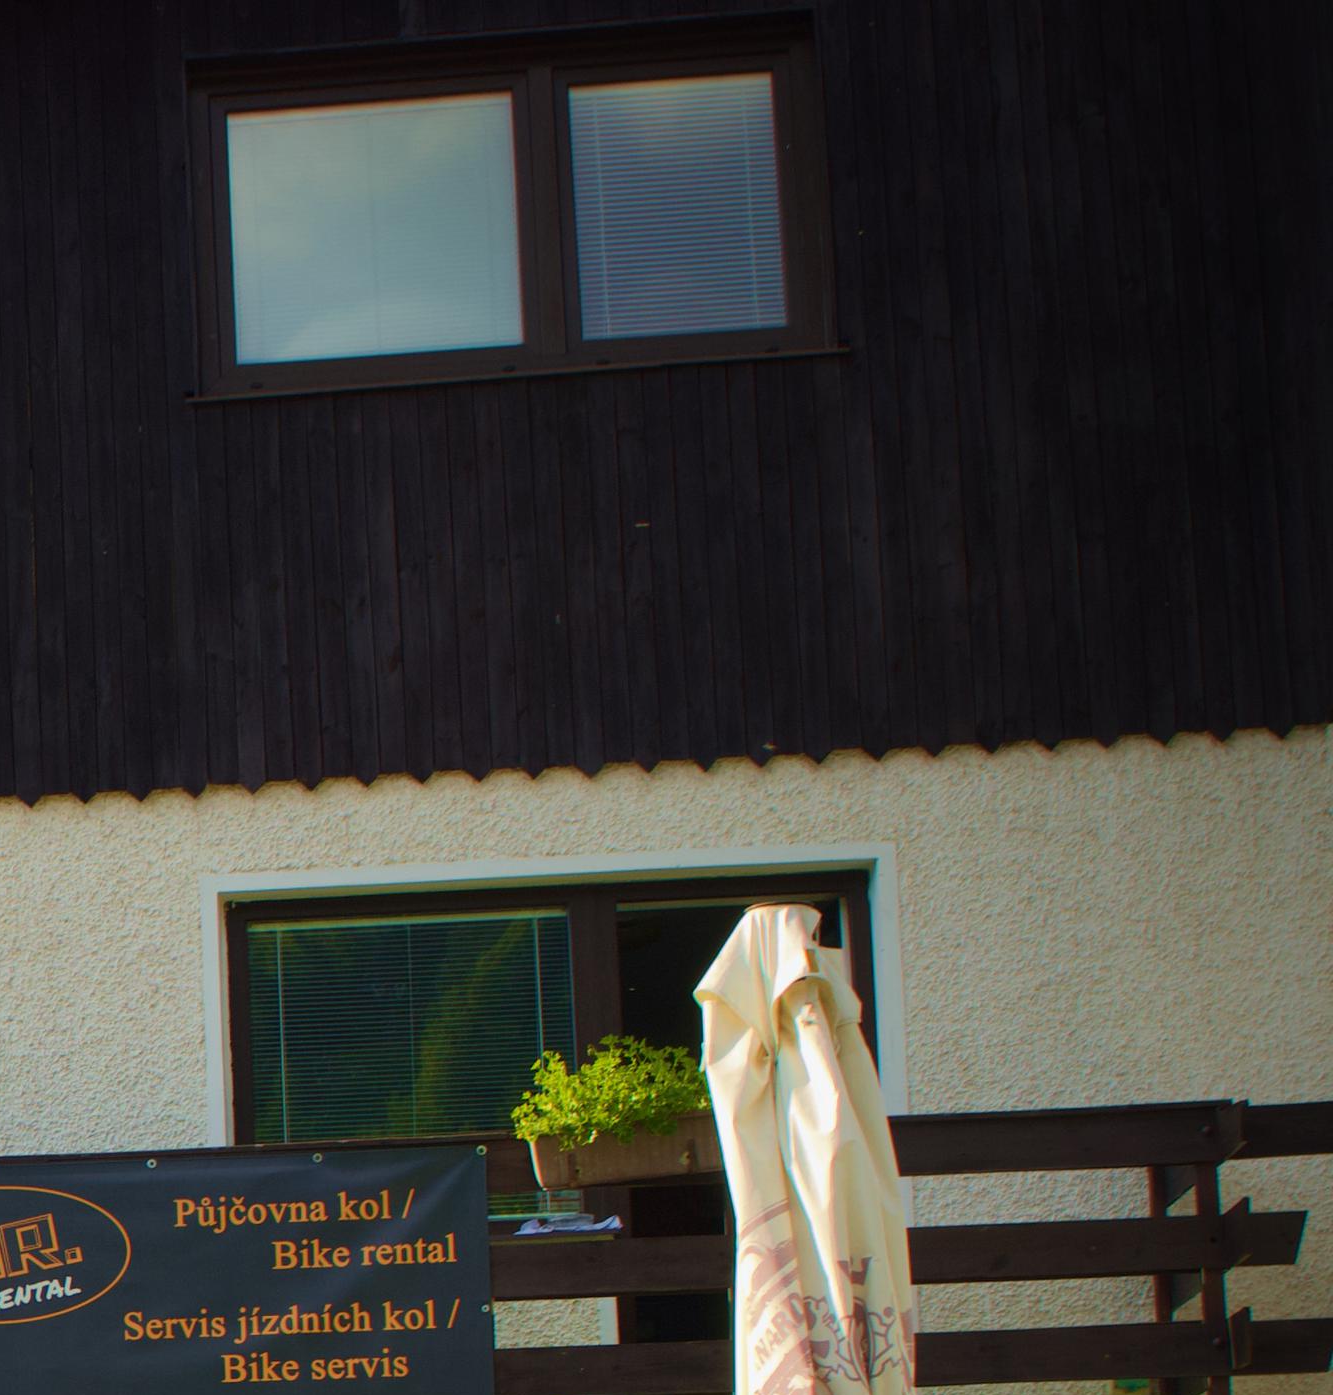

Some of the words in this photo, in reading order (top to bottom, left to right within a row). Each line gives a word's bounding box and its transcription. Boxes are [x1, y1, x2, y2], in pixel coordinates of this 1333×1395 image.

[173, 1196, 329, 1234] Půjčovna
[337, 1189, 391, 1222] kol
[271, 1239, 351, 1271] Bike
[360, 1233, 457, 1267] rental
[123, 1310, 226, 1343] Servis
[233, 1303, 373, 1347] jízdních
[382, 1299, 437, 1332] kol
[221, 1352, 301, 1384] Bike
[311, 1348, 409, 1381] servis
